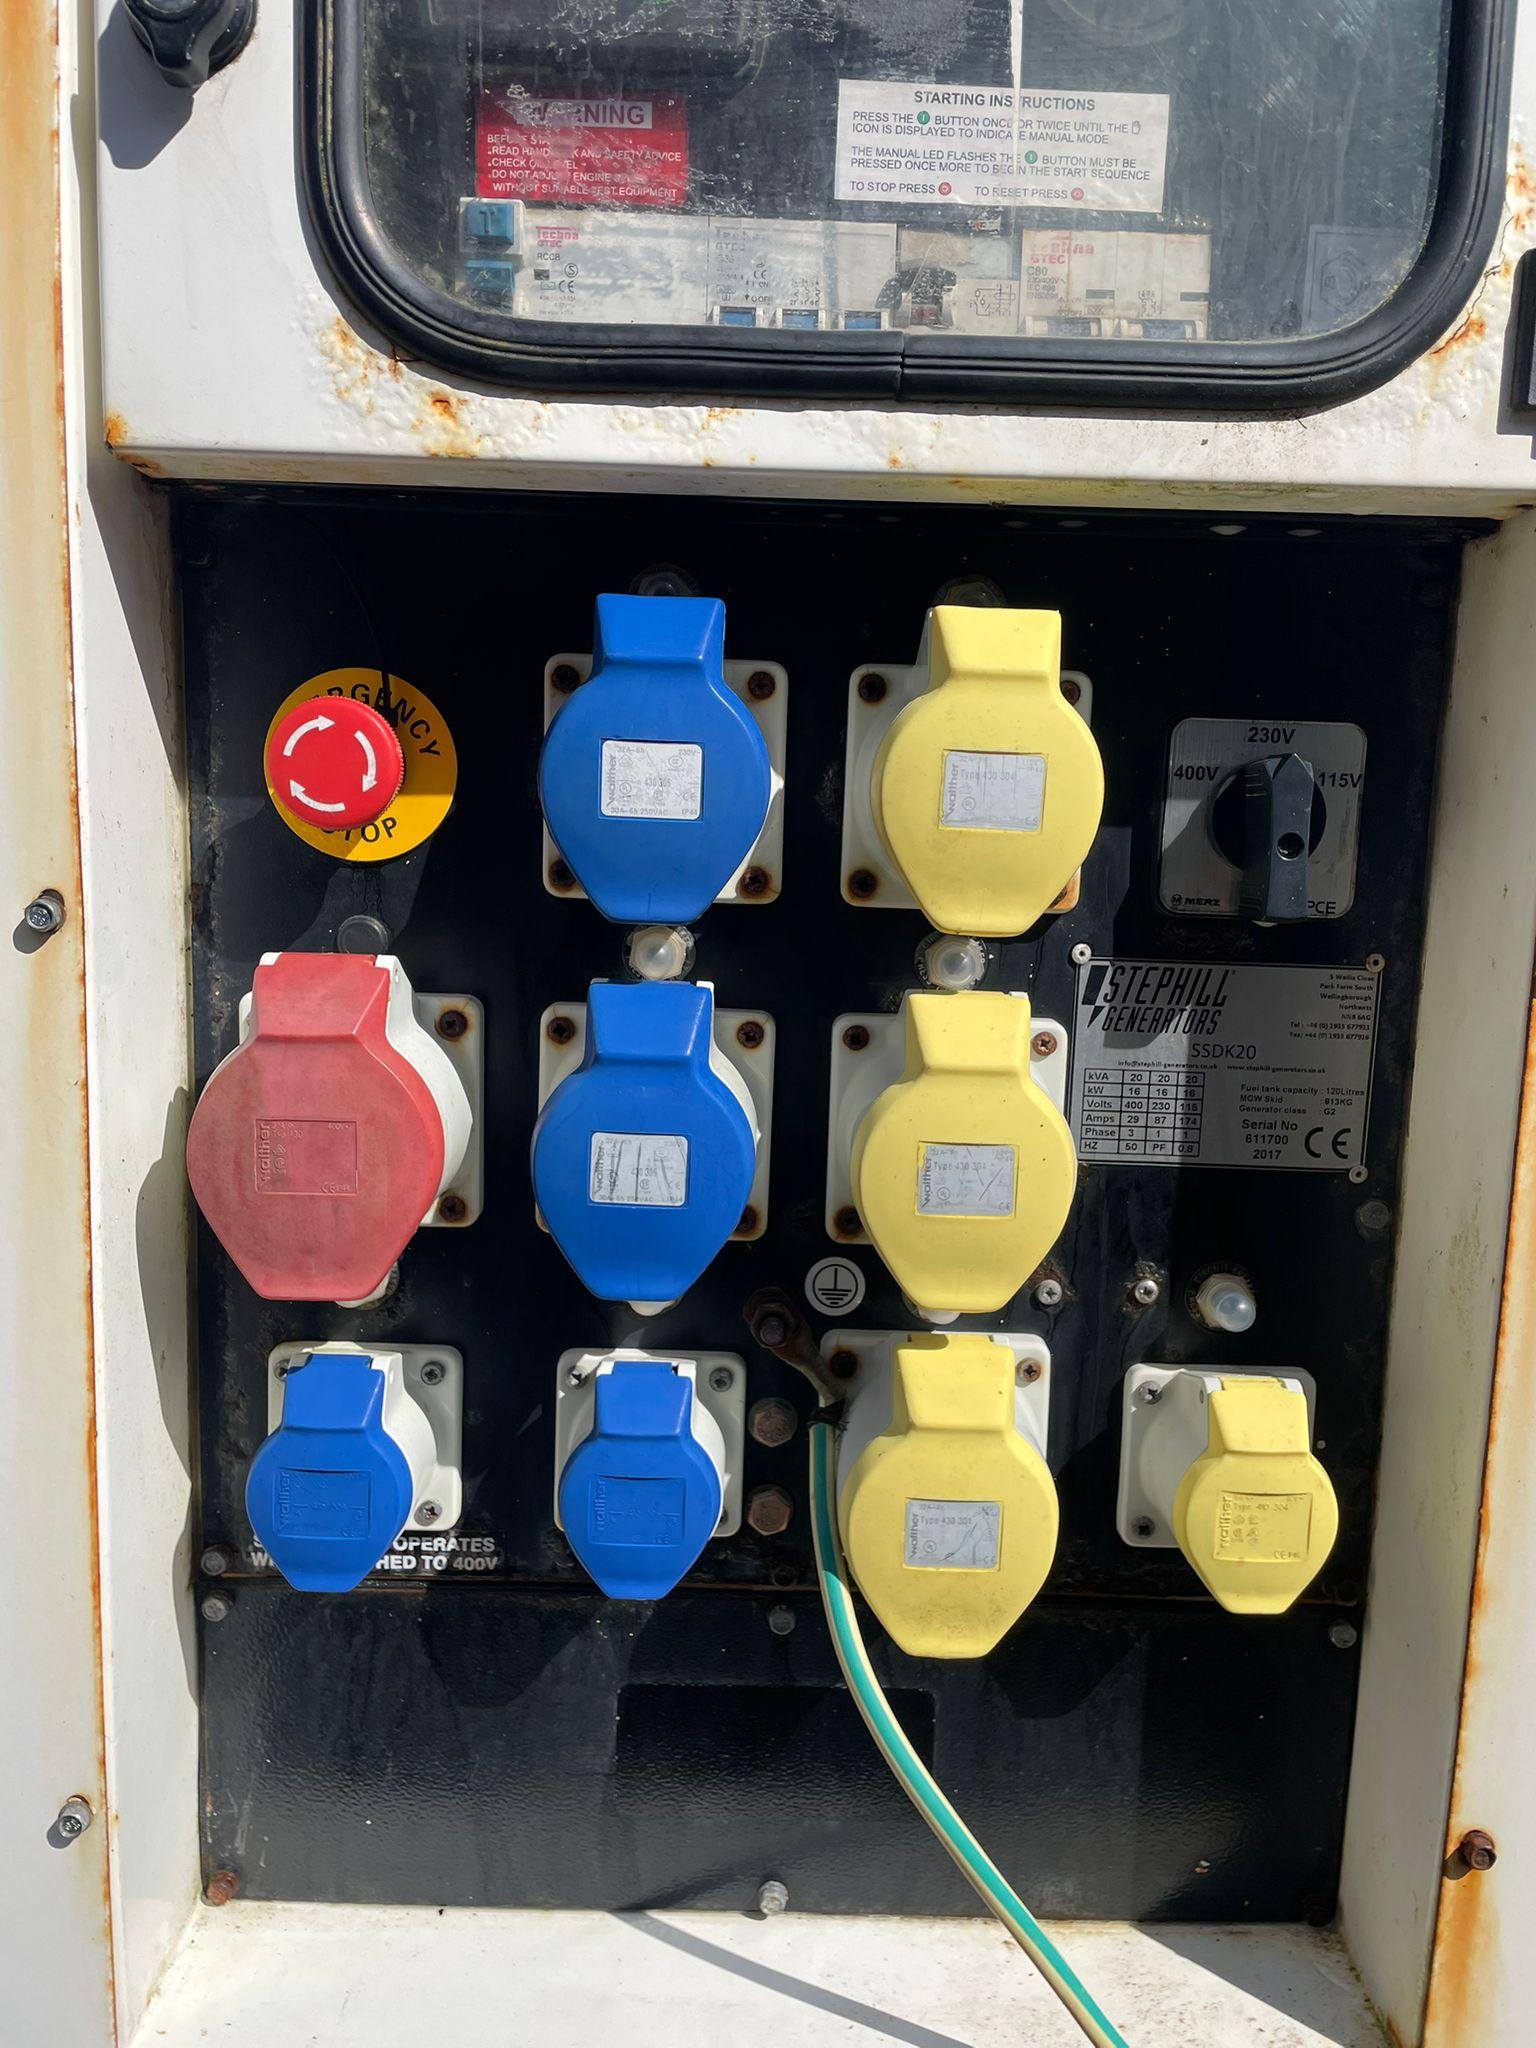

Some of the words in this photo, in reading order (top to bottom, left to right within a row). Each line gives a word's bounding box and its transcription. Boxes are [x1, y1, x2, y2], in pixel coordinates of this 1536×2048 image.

[914, 91, 985, 106] STARTING
[989, 94, 1096, 111] INSRUCTIONS
[853, 111, 889, 122] PRESS
[892, 113, 914, 124] THE
[935, 116, 979, 126] BUTTON
[1036, 120, 1071, 131] TWICE
[1074, 122, 1104, 132] UNTIL
[1107, 123, 1128, 133] THE
[852, 123, 879, 133] ICON
[882, 124, 892, 134] IS
[895, 125, 955, 137] DISPLAYED
[959, 128, 973, 138] TO
[976, 129, 1026, 140] INDICAE
[1029, 132, 1074, 142] MANUAL
[1076, 134, 1109, 144] MODE
[645, 151, 682, 161] ADVICE
[851, 146, 872, 156] THE
[875, 147, 920, 158] MANUAL
[923, 149, 944, 160] LED
[947, 150, 997, 162] FLASHES
[1042, 155, 1086, 166] BUTTON
[1089, 157, 1120, 168] MUST
[1122, 158, 1136, 168] BE
[851, 158, 902, 169] PRESSED
[905, 161, 936, 171] ONCE
[939, 162, 971, 172] MORE
[974, 163, 989, 173] TO
[992, 164, 1026, 175] BEGN
[1029, 166, 1050, 176] THE
[1053, 167, 1088, 177] START
[1091, 168, 1151, 180] SEQUENCE
[850, 181, 864, 191] TO
[867, 182, 897, 192] STOP
[899, 183, 936, 194] PRESS
[974, 186, 989, 196] TO
[992, 187, 1029, 198] RESET
[1031, 188, 1068, 199] PRESS
[1247, 726, 1296, 744] 230V
[1173, 765, 1220, 781] 400V
[1317, 772, 1363, 789] 115V
[1184, 897, 1221, 906] MERZ
[1103, 965, 1230, 1008] STEPHILL
[1102, 1005, 1222, 1035] GENERATORS
[1191, 1043, 1256, 1060] SSDK20
[1088, 1072, 1109, 1081] kVA
[1130, 1073, 1143, 1082] 20
[1158, 1074, 1170, 1083] 20
[1185, 1075, 1198, 1084] 20
[1087, 1086, 1104, 1095] kW
[1129, 1087, 1141, 1096] 16
[1156, 1088, 1168, 1097] 16
[1184, 1089, 1196, 1098] 16
[1240, 1084, 1260, 1092] Fuel
[1262, 1085, 1280, 1093] tank
[1282, 1087, 1319, 1096] capacity
[1086, 1099, 1113, 1109] Volts
[1124, 1101, 1143, 1110] 400
[1152, 1102, 1171, 1110] 230
[1179, 1103, 1198, 1111] 115
[1240, 1095, 1263, 1103] MGW
[1264, 1095, 1283, 1104] Skid
[1238, 1104, 1282, 1114] Generator
[1284, 1106, 1307, 1114] class
[1323, 1108, 1336, 1116] G2
[1085, 1114, 1115, 1124] Amps
[1127, 1115, 1139, 1124] 29
[1154, 1116, 1166, 1125] 87
[1179, 1117, 1197, 1126] 174
[1241, 1119, 1277, 1130] Serial
[1280, 1120, 1298, 1131] No
[1084, 1127, 1116, 1137] Phase
[1128, 1128, 1134, 1137] 3
[1245, 1134, 1289, 1145] 611700
[1083, 1141, 1098, 1150] HZ
[1125, 1142, 1138, 1151] 50
[1152, 1143, 1166, 1152] PF
[1178, 1144, 1194, 1153] 0.8
[1304, 1126, 1351, 1160] CE
[1252, 1149, 1282, 1160] 2017
[392, 1537, 496, 1552] OPERATES
[421, 1555, 447, 1570] TO
[453, 1555, 499, 1571] 400V
